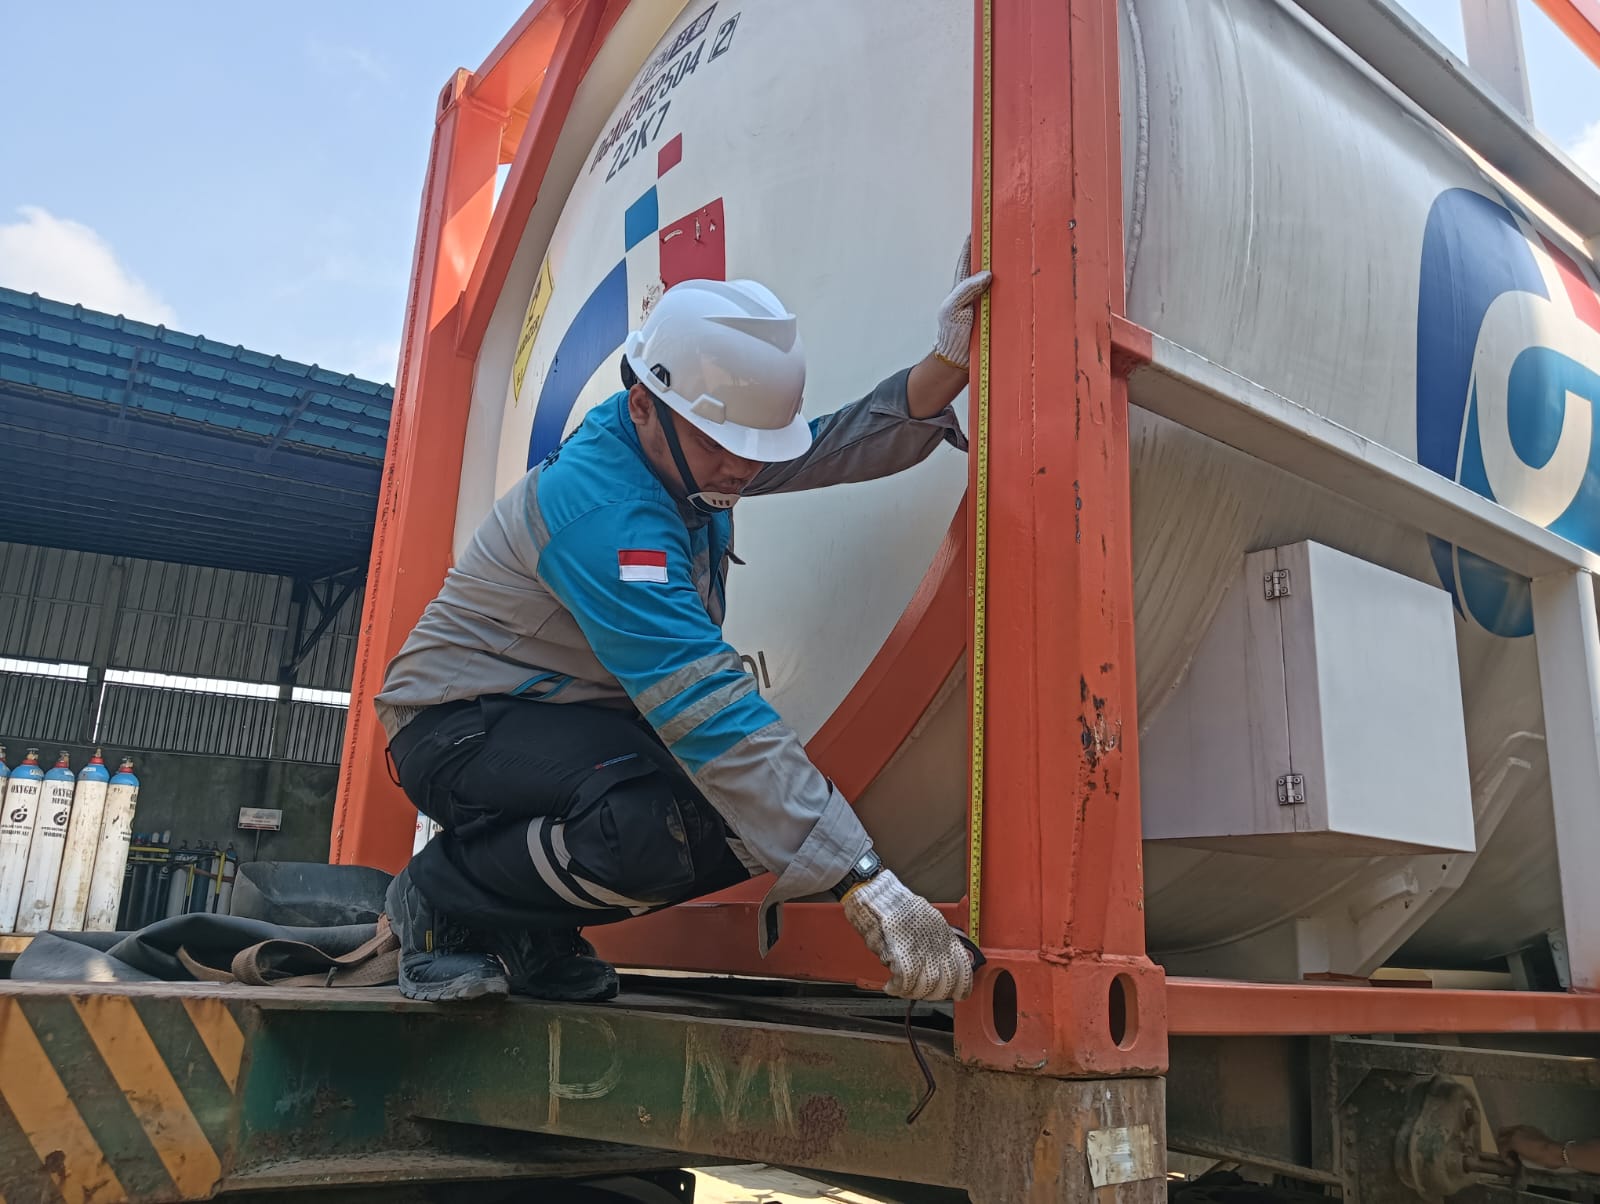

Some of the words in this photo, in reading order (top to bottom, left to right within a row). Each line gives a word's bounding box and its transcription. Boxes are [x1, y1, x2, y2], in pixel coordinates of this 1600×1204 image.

[712, 18, 735, 58] 2
[605, 100, 671, 183] 22K7
[11, 784, 37, 795] OXYGEN
